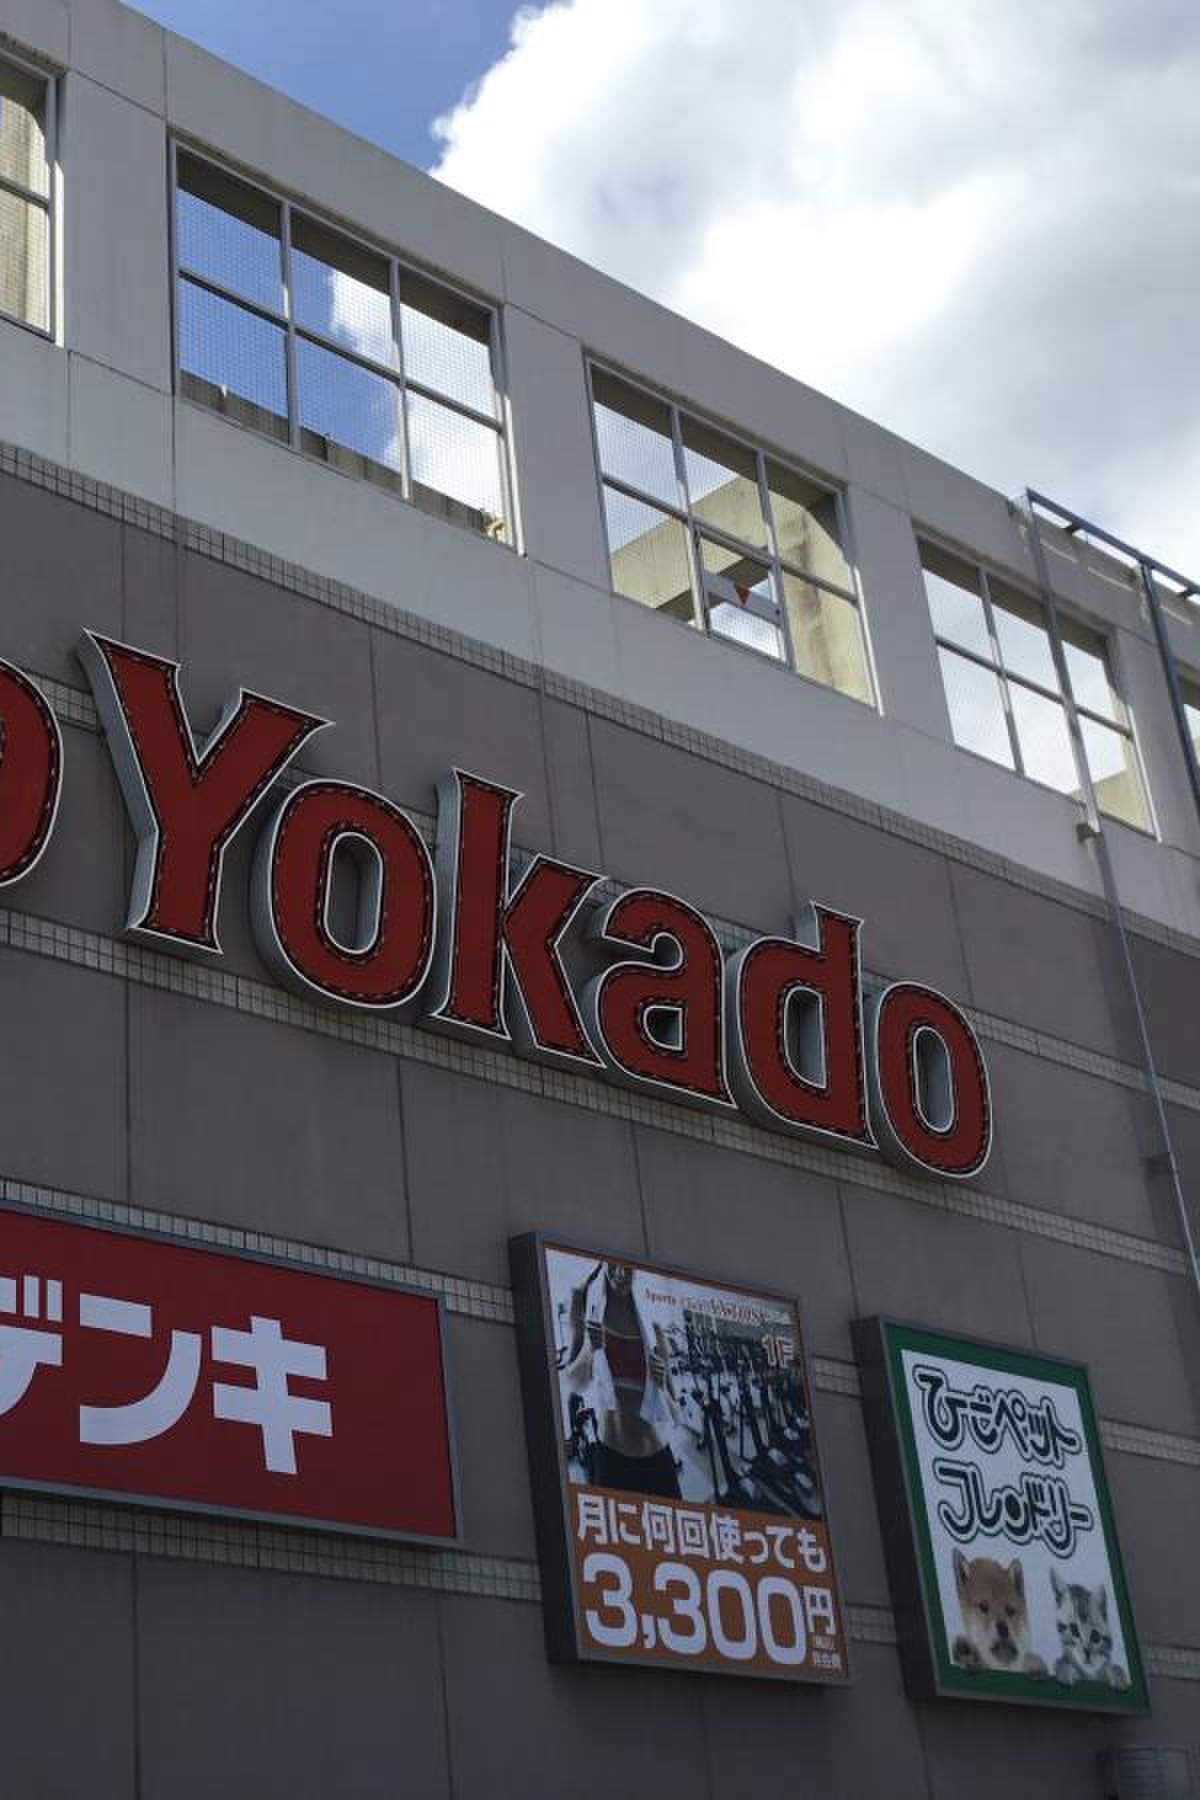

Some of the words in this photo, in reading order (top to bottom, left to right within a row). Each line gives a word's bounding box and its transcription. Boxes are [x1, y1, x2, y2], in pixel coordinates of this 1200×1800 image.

[577, 1493, 828, 1574] 月に何回使っても
